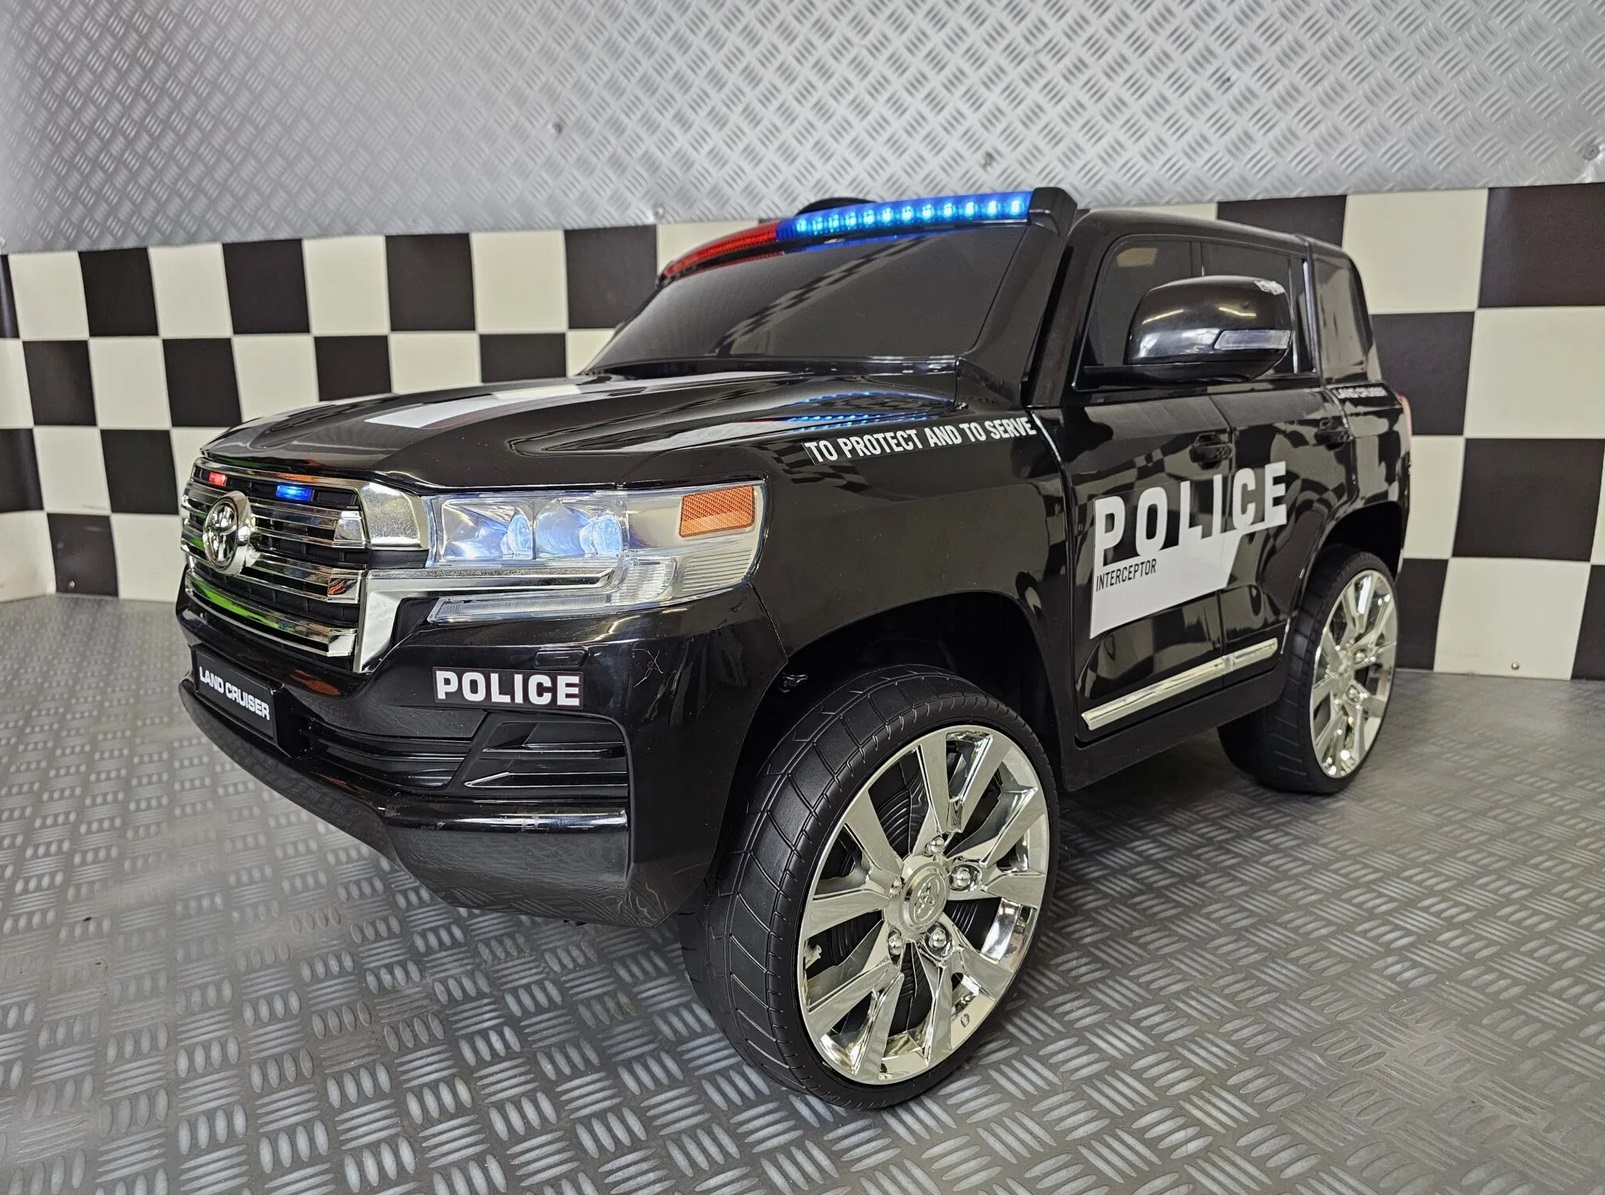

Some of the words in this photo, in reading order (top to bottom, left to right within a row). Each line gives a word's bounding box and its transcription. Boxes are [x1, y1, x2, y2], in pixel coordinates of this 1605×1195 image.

[804, 439, 838, 463] TO
[836, 429, 924, 459] PROTECT
[924, 424, 963, 447] AND
[960, 421, 987, 442] TO
[984, 416, 1037, 440] SERVE
[1094, 460, 1287, 567] POLICE
[1095, 558, 1157, 593] INTERCEPTOR
[199, 665, 225, 694] LAND
[225, 681, 270, 721] CRUISER
[435, 670, 581, 706] POLICE
